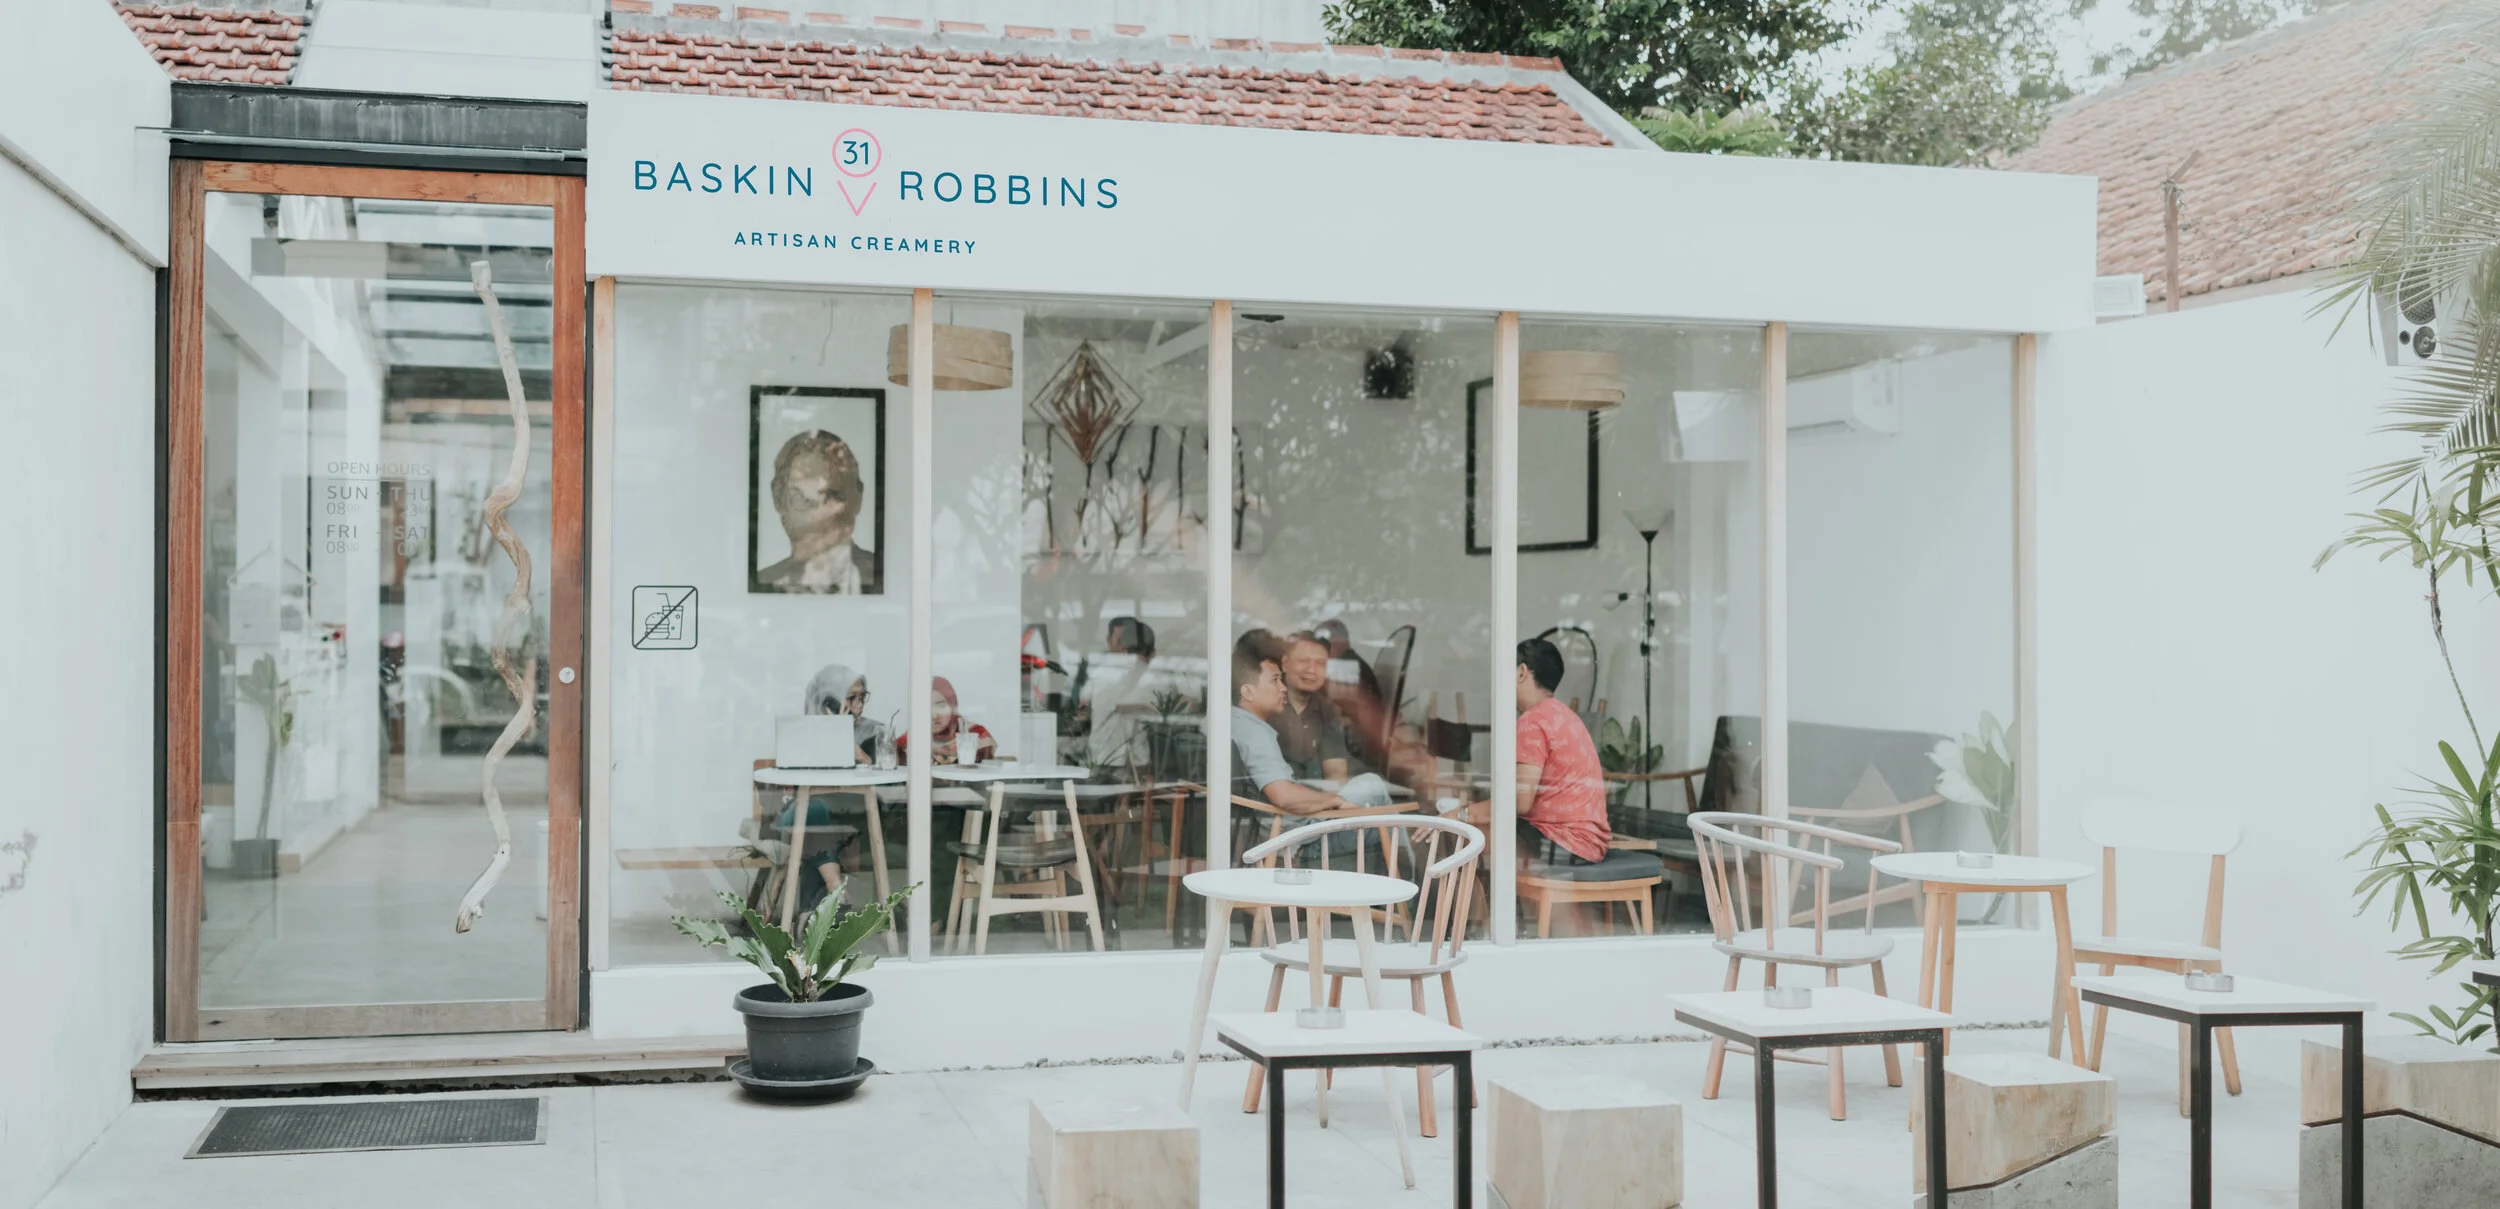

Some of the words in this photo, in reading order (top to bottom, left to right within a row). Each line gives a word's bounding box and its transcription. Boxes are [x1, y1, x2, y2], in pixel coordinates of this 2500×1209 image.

[843, 141, 868, 165] 31
[635, 160, 811, 196] BASKIN
[901, 171, 1117, 208] ROBBINS
[734, 232, 836, 248] ARTISAN
[851, 236, 975, 254] CREAMERY
[327, 461, 370, 475] OPEN
[376, 462, 431, 476] HOURS
[327, 485, 368, 500] SUN
[391, 486, 432, 502] THU
[326, 524, 357, 539] FRI
[395, 526, 429, 540] SAT
